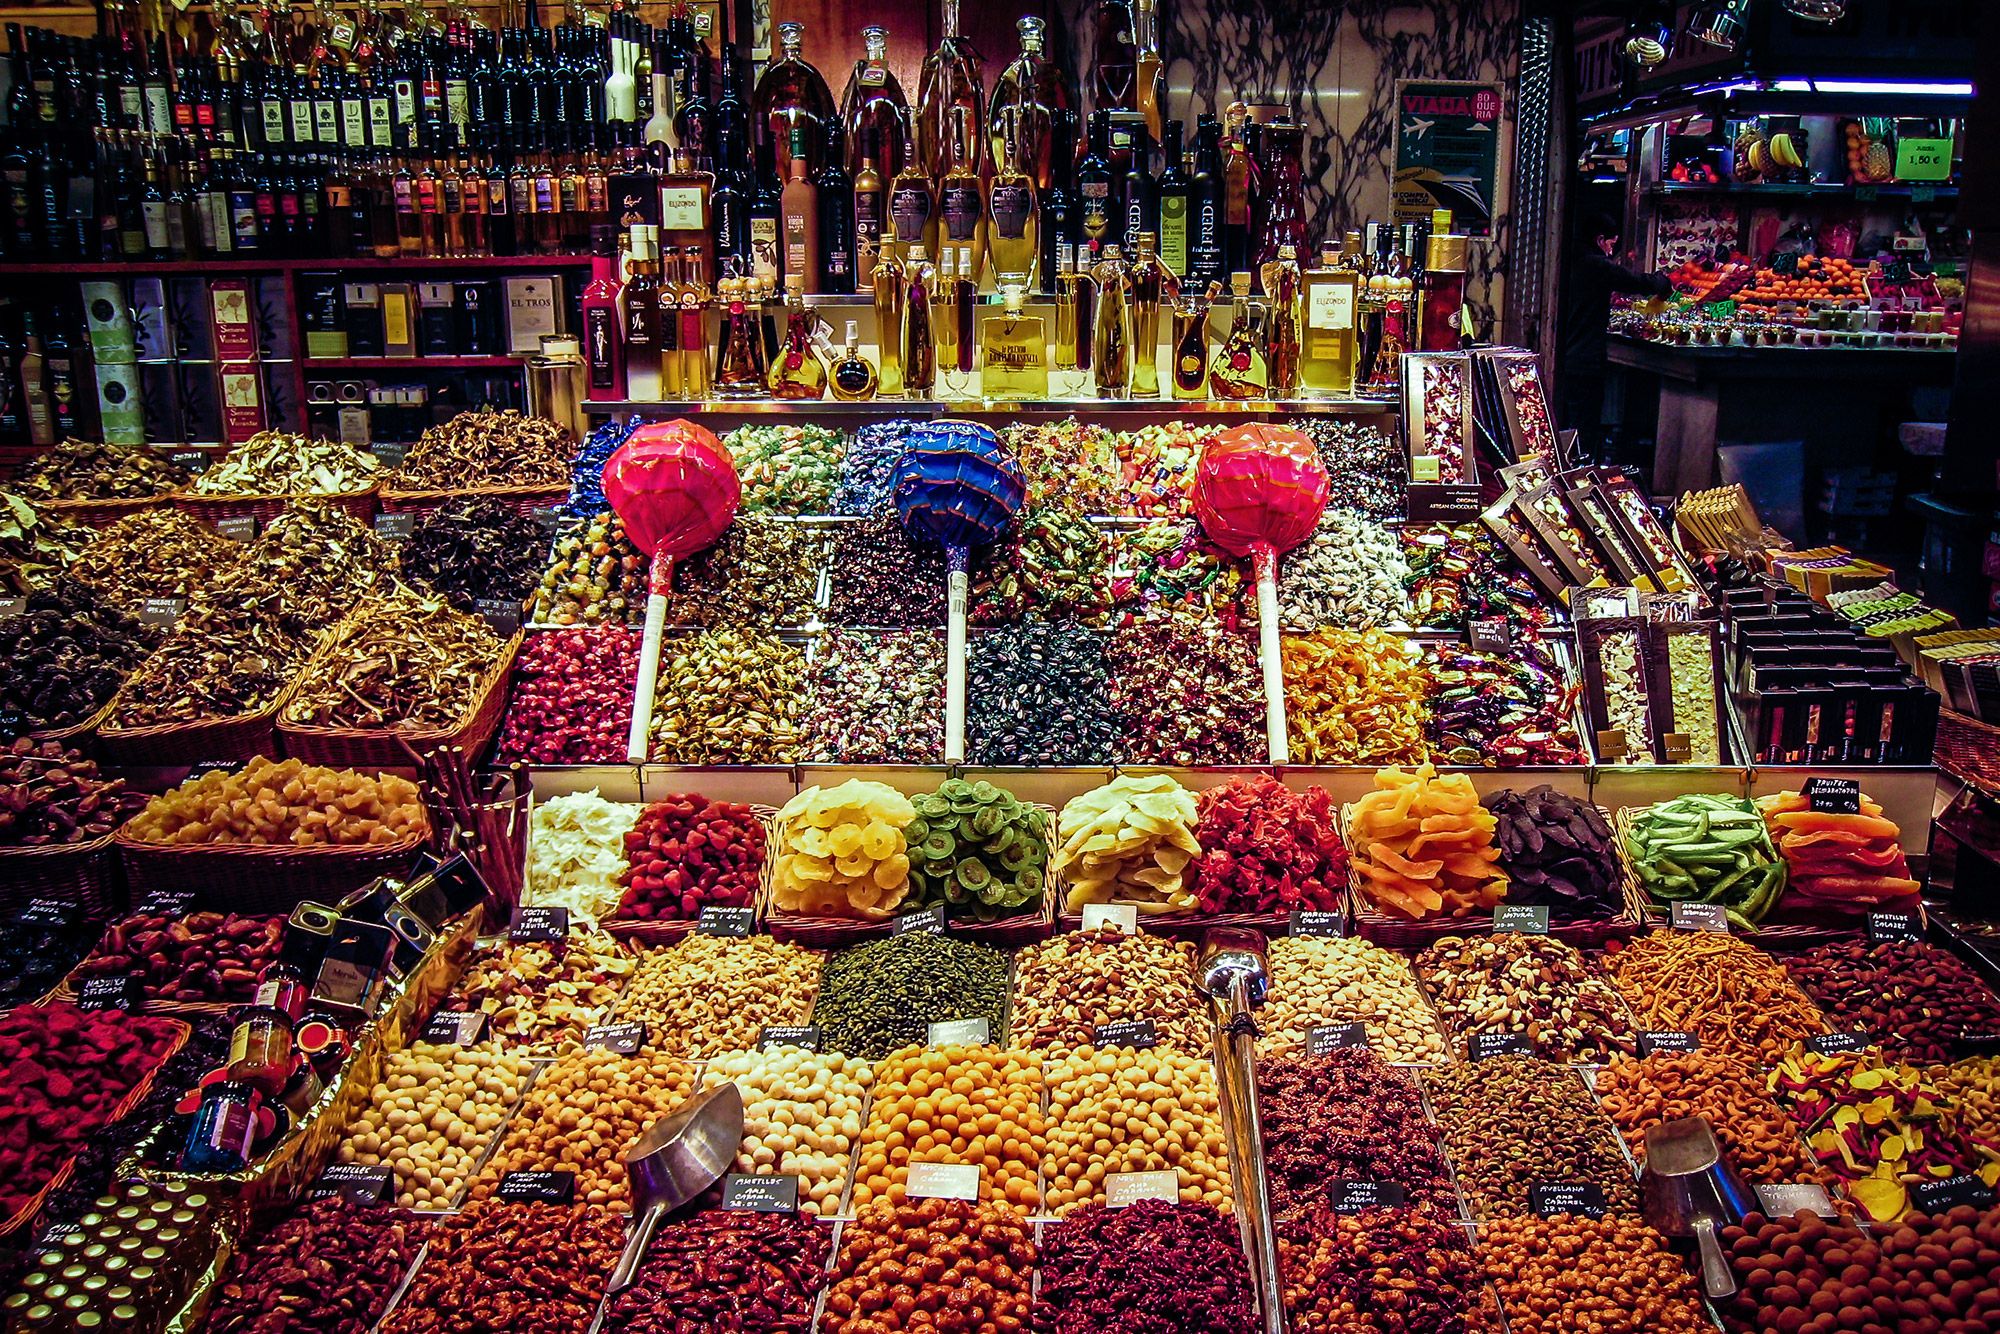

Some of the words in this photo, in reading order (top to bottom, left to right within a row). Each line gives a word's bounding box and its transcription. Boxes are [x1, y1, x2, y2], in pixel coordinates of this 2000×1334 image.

[1477, 92, 1490, 101] BO
[1476, 101, 1496, 111] QUE
[1475, 110, 1492, 119] RIA
[1201, 205, 1215, 244] FRED
[511, 299, 523, 307] EL
[526, 299, 551, 307] TROS
[1315, 297, 1347, 305] ELIZONDO
[1095, 1020, 1147, 1033] MACADAMIA
[1815, 1033, 1851, 1043] COCTEL
[1654, 1039, 1688, 1047] PICANT
[1346, 1182, 1379, 1190] COCTEL
[1919, 1174, 1973, 1193] CATANIES
[1539, 1184, 1585, 1193] AVELLANA
[1544, 1198, 1585, 1206] CARAMEL
